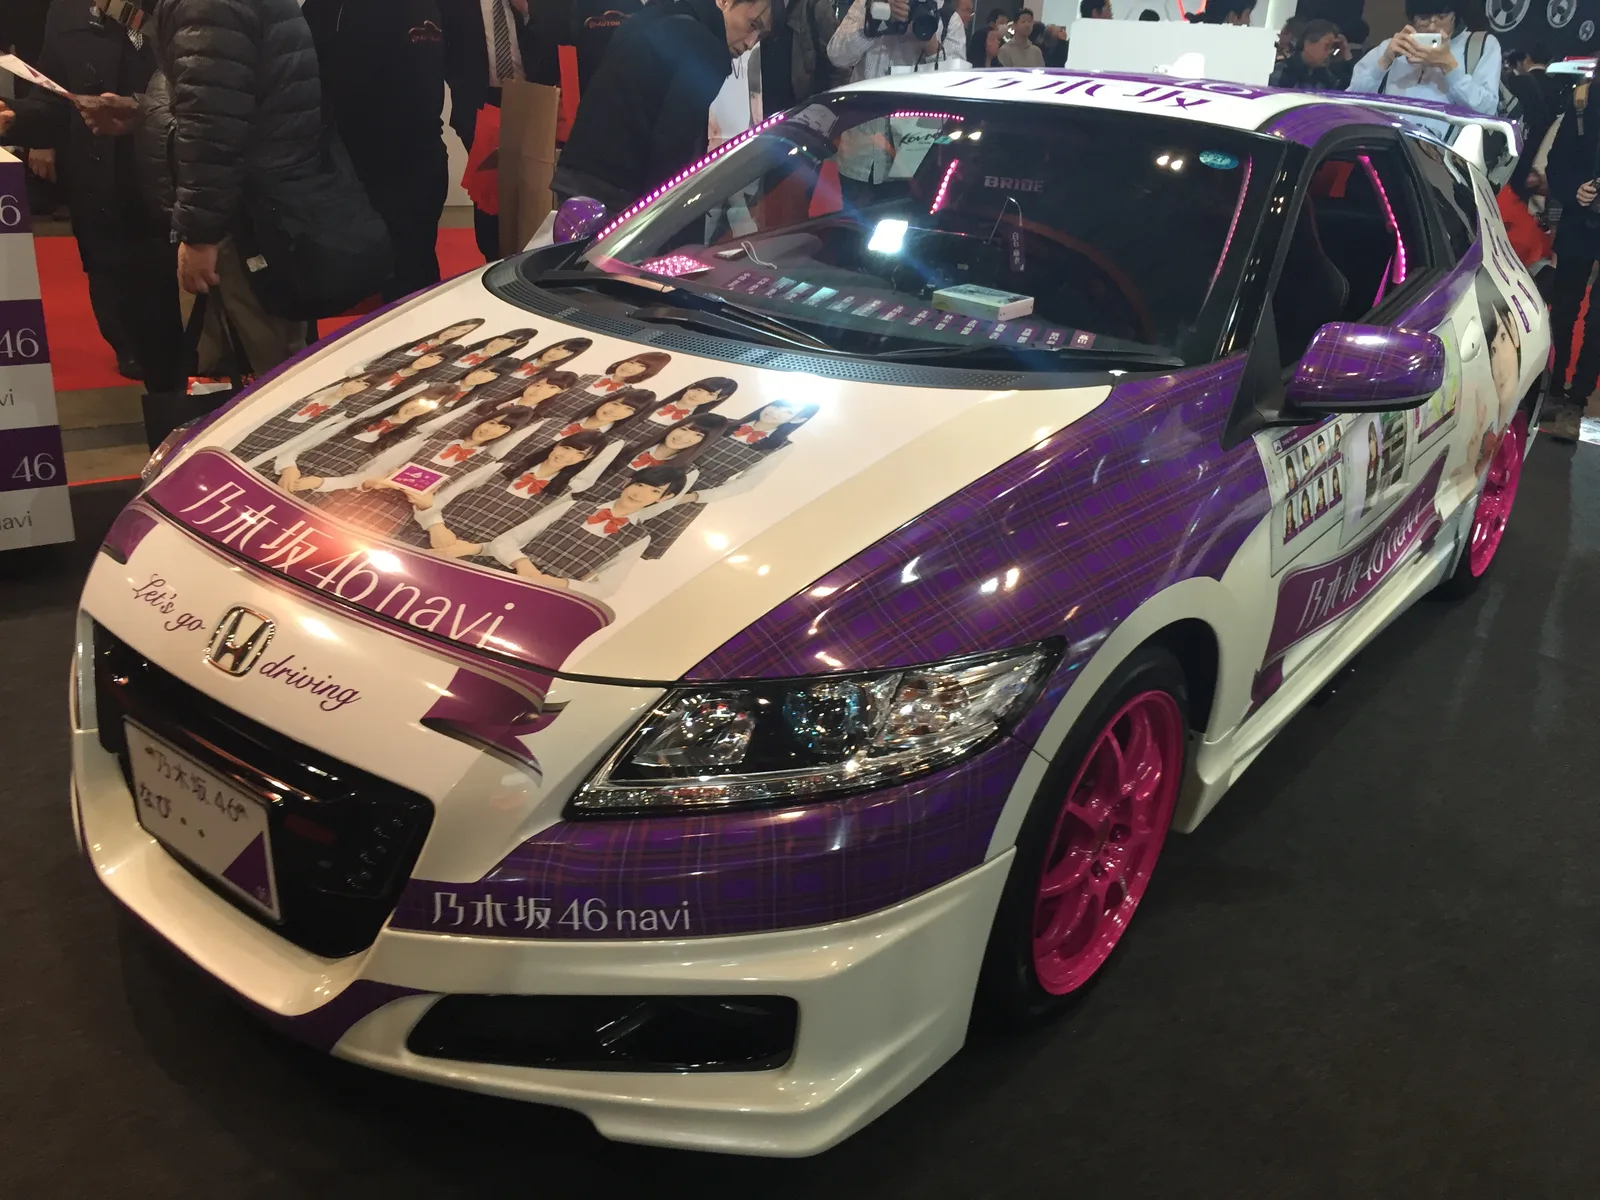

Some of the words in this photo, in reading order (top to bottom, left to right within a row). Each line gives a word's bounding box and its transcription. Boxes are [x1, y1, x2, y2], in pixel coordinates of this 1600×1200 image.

[984, 175, 1045, 193] BRIDE
[12, 452, 57, 483] 46
[132, 573, 178, 615] Let's
[163, 611, 206, 632] go
[259, 654, 362, 712] driving
